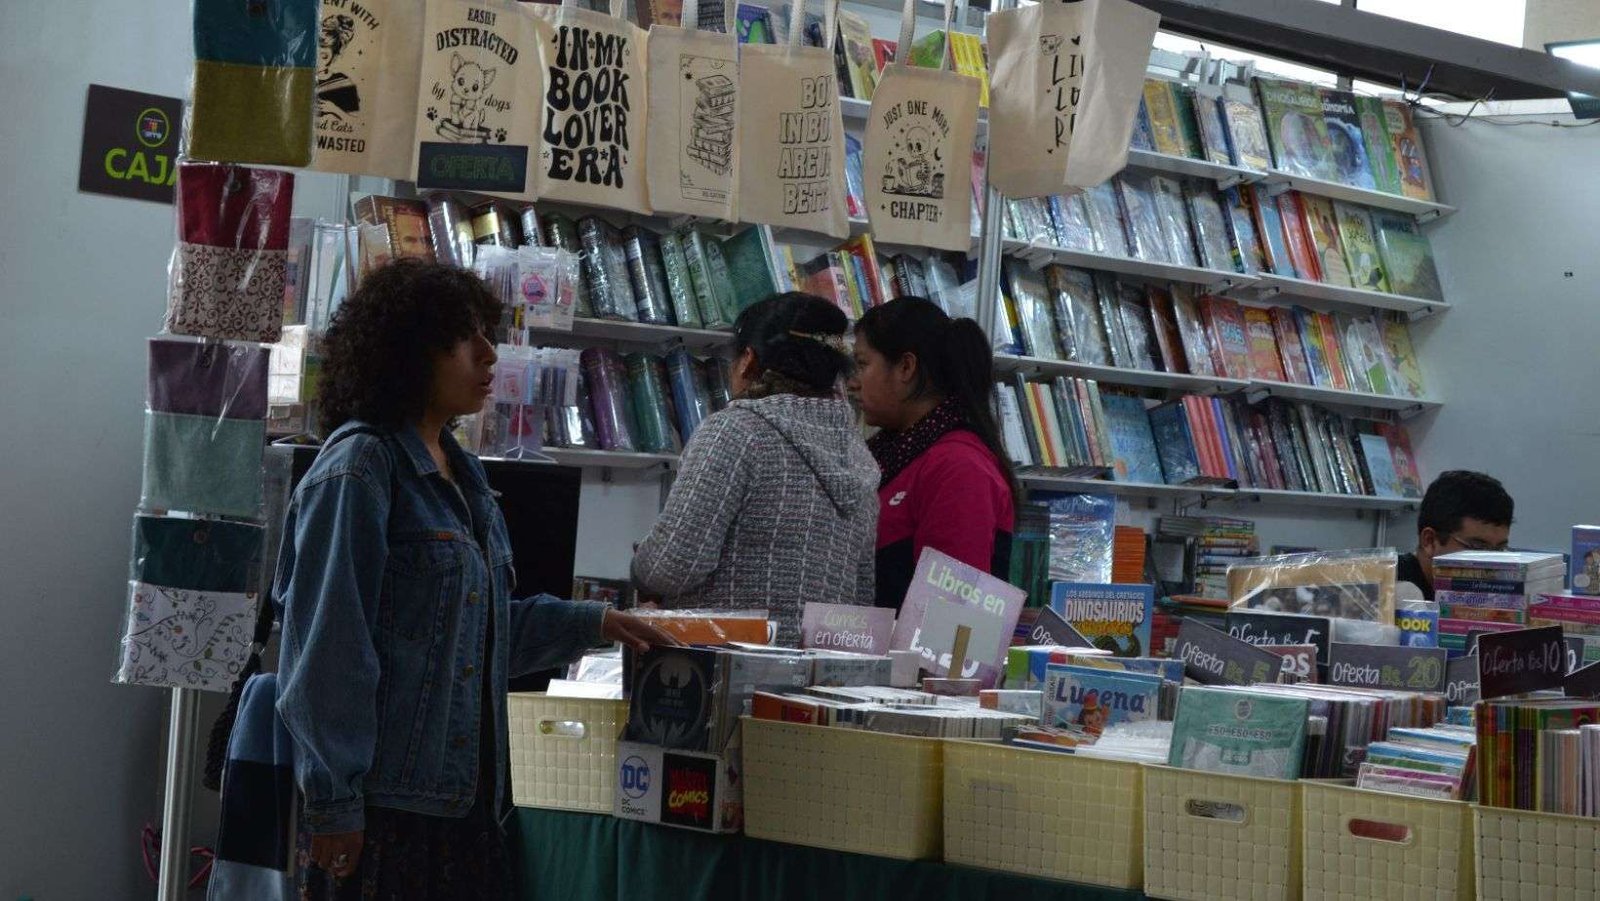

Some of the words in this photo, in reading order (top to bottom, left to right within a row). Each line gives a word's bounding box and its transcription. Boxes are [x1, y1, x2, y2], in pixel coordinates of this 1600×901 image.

[350, 4, 380, 30] WITH
[436, 27, 519, 66] DISTRACTED
[556, 25, 589, 71] IN
[594, 31, 627, 69] MY
[1052, 54, 1084, 85] LI
[431, 81, 446, 100] by
[484, 94, 511, 112] dogs
[546, 66, 630, 112] BOOK
[801, 75, 832, 108] BO
[330, 120, 353, 133] Cats
[543, 103, 630, 150] LOVER
[779, 112, 802, 144] IN
[883, 103, 902, 129] JUST
[907, 100, 928, 115] ONE
[932, 106, 949, 138] MORE
[317, 135, 366, 153] WASTED
[430, 154, 514, 181] OFERTA
[548, 144, 624, 189] ERA
[778, 147, 817, 179] ARE
[890, 201, 939, 223] CHAPTER
[927, 561, 981, 604] Libros
[983, 594, 1006, 616] en
[1065, 599, 1145, 624] DINOSAURIOS
[815, 631, 831, 645] en
[833, 630, 873, 649] oferta
[1180, 641, 1225, 675] Oferta
[1332, 662, 1380, 685] Oferta
[1407, 655, 1441, 688] 20
[1543, 640, 1560, 673] 10
[622, 763, 649, 791] DC
[621, 806, 645, 815] COMICS
[668, 789, 709, 809] COMICS
